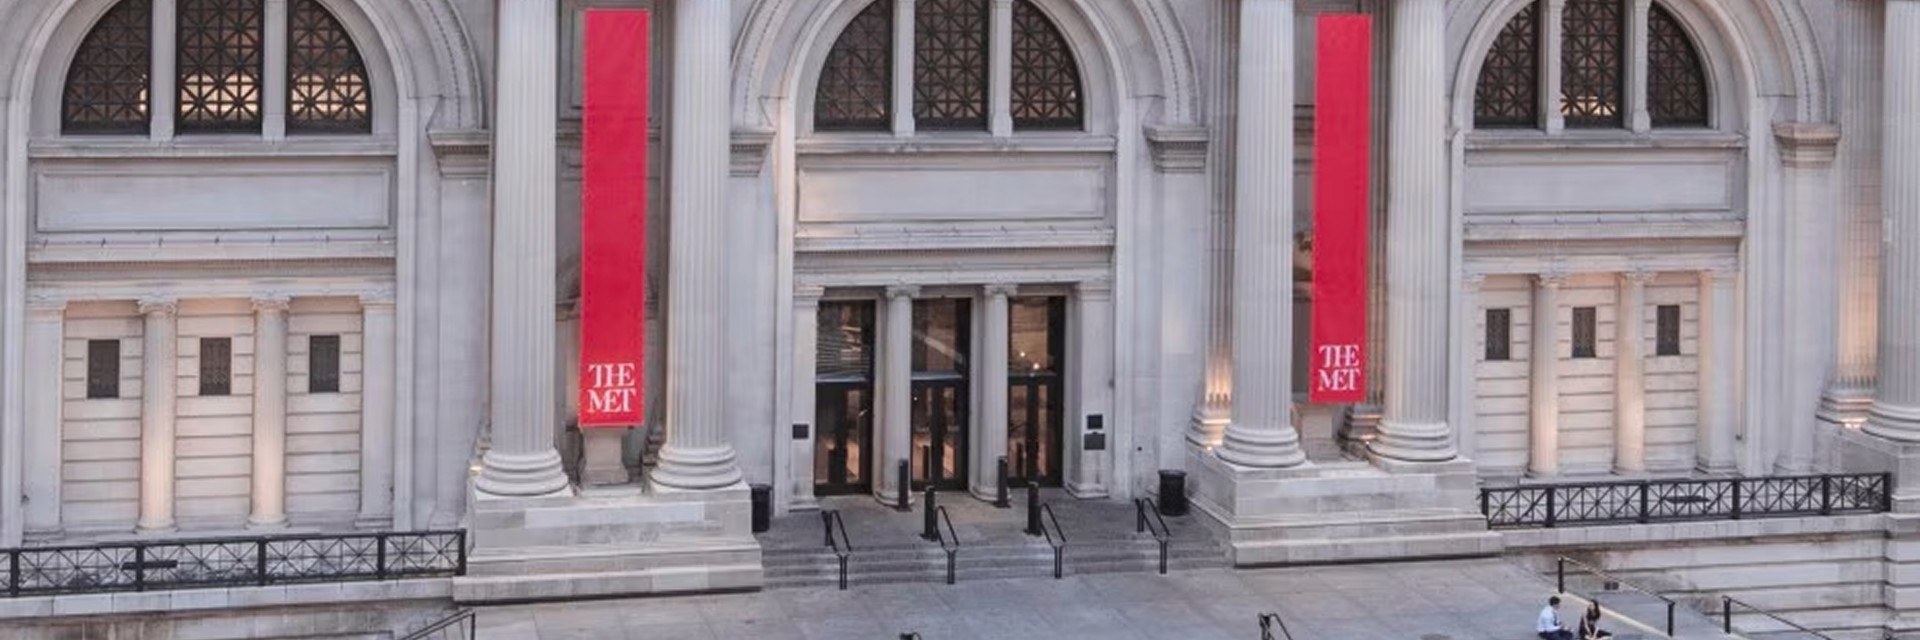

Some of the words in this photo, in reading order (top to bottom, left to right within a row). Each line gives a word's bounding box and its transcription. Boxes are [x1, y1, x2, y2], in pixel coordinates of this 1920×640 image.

[1318, 345, 1359, 367] THE
[587, 363, 635, 388] THE
[1318, 368, 1361, 391] MET
[587, 388, 637, 413] MET
